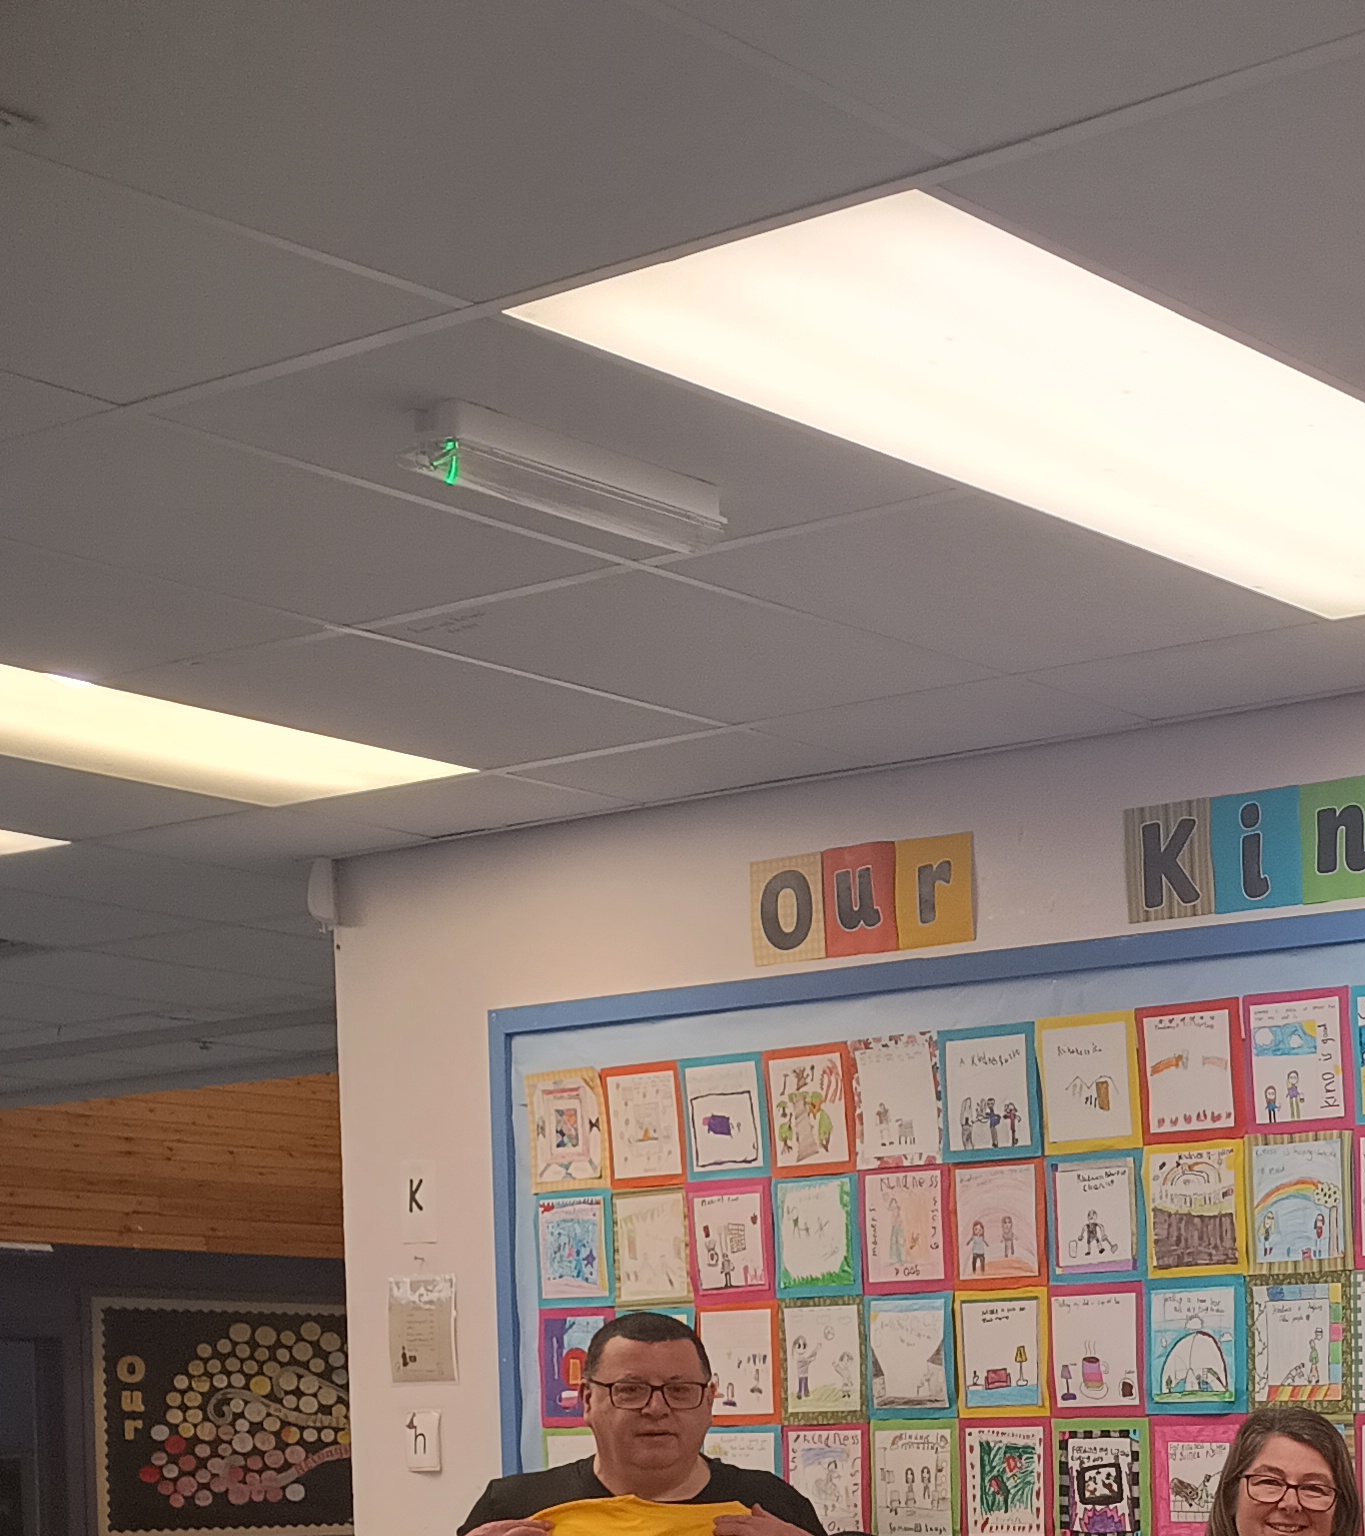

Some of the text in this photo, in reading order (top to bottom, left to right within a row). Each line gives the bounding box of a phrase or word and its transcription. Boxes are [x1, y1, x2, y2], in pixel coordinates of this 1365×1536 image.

[760, 853, 952, 954] Our
[408, 1178, 423, 1203] K
[117, 1355, 146, 1440] Our
